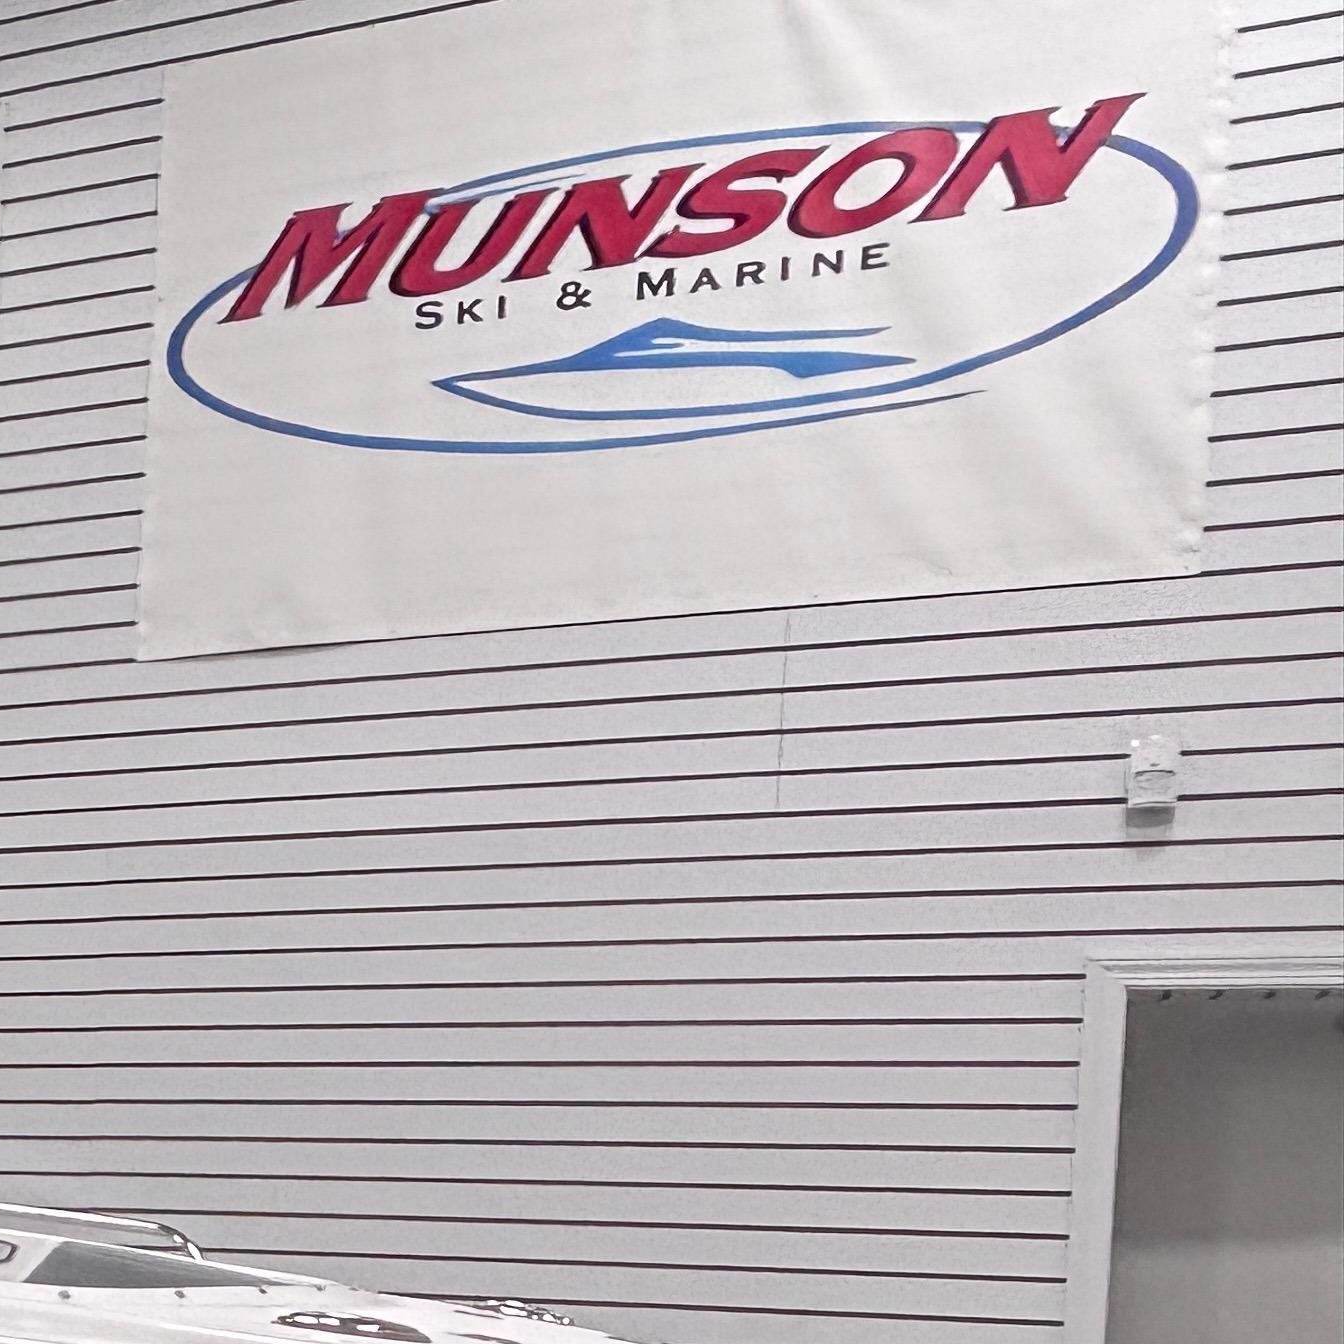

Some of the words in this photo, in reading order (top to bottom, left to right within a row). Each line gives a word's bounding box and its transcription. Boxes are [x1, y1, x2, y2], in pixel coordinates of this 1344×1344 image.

[218, 92, 1146, 324] MUNSON
[415, 296, 507, 330] SKI
[555, 281, 592, 310] &
[636, 242, 891, 300] MARINE
